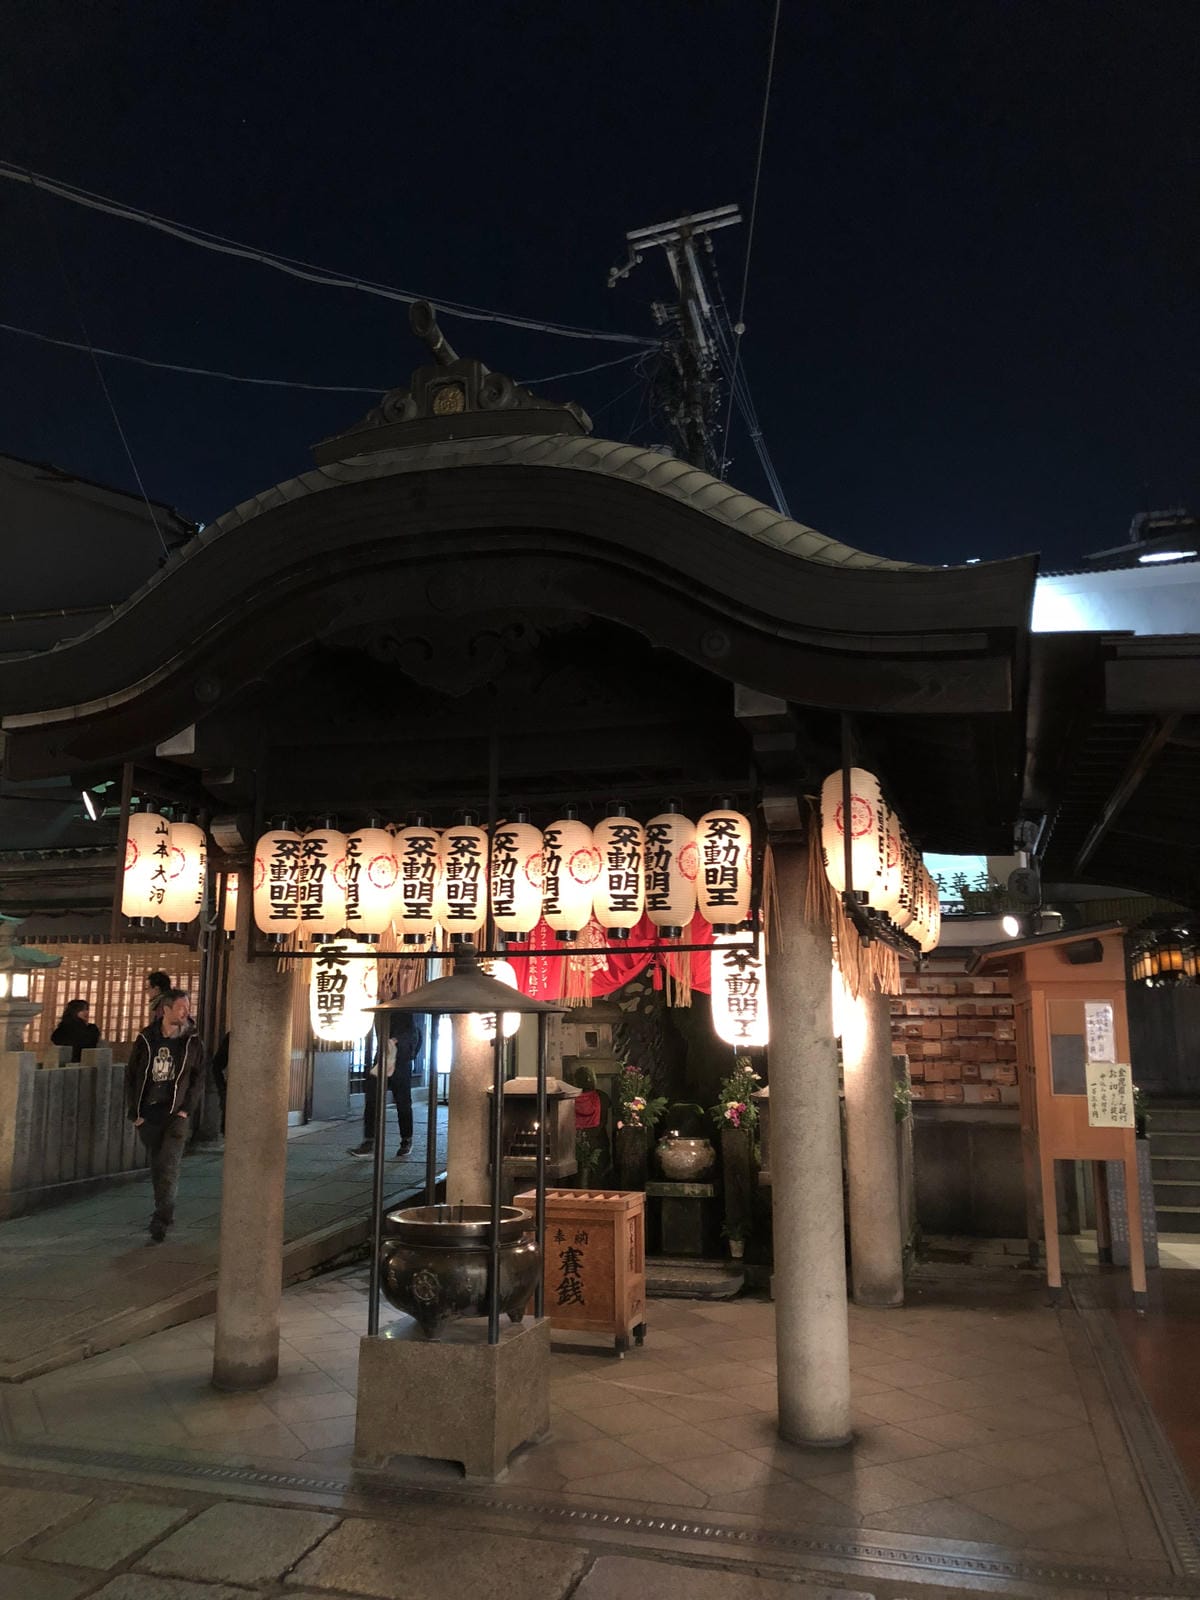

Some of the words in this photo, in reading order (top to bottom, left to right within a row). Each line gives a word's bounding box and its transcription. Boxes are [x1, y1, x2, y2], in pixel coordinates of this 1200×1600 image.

[149, 820, 169, 905] 山本大河
[553, 1228, 589, 1246] 奉納
[555, 1246, 585, 1306] 賽銭
